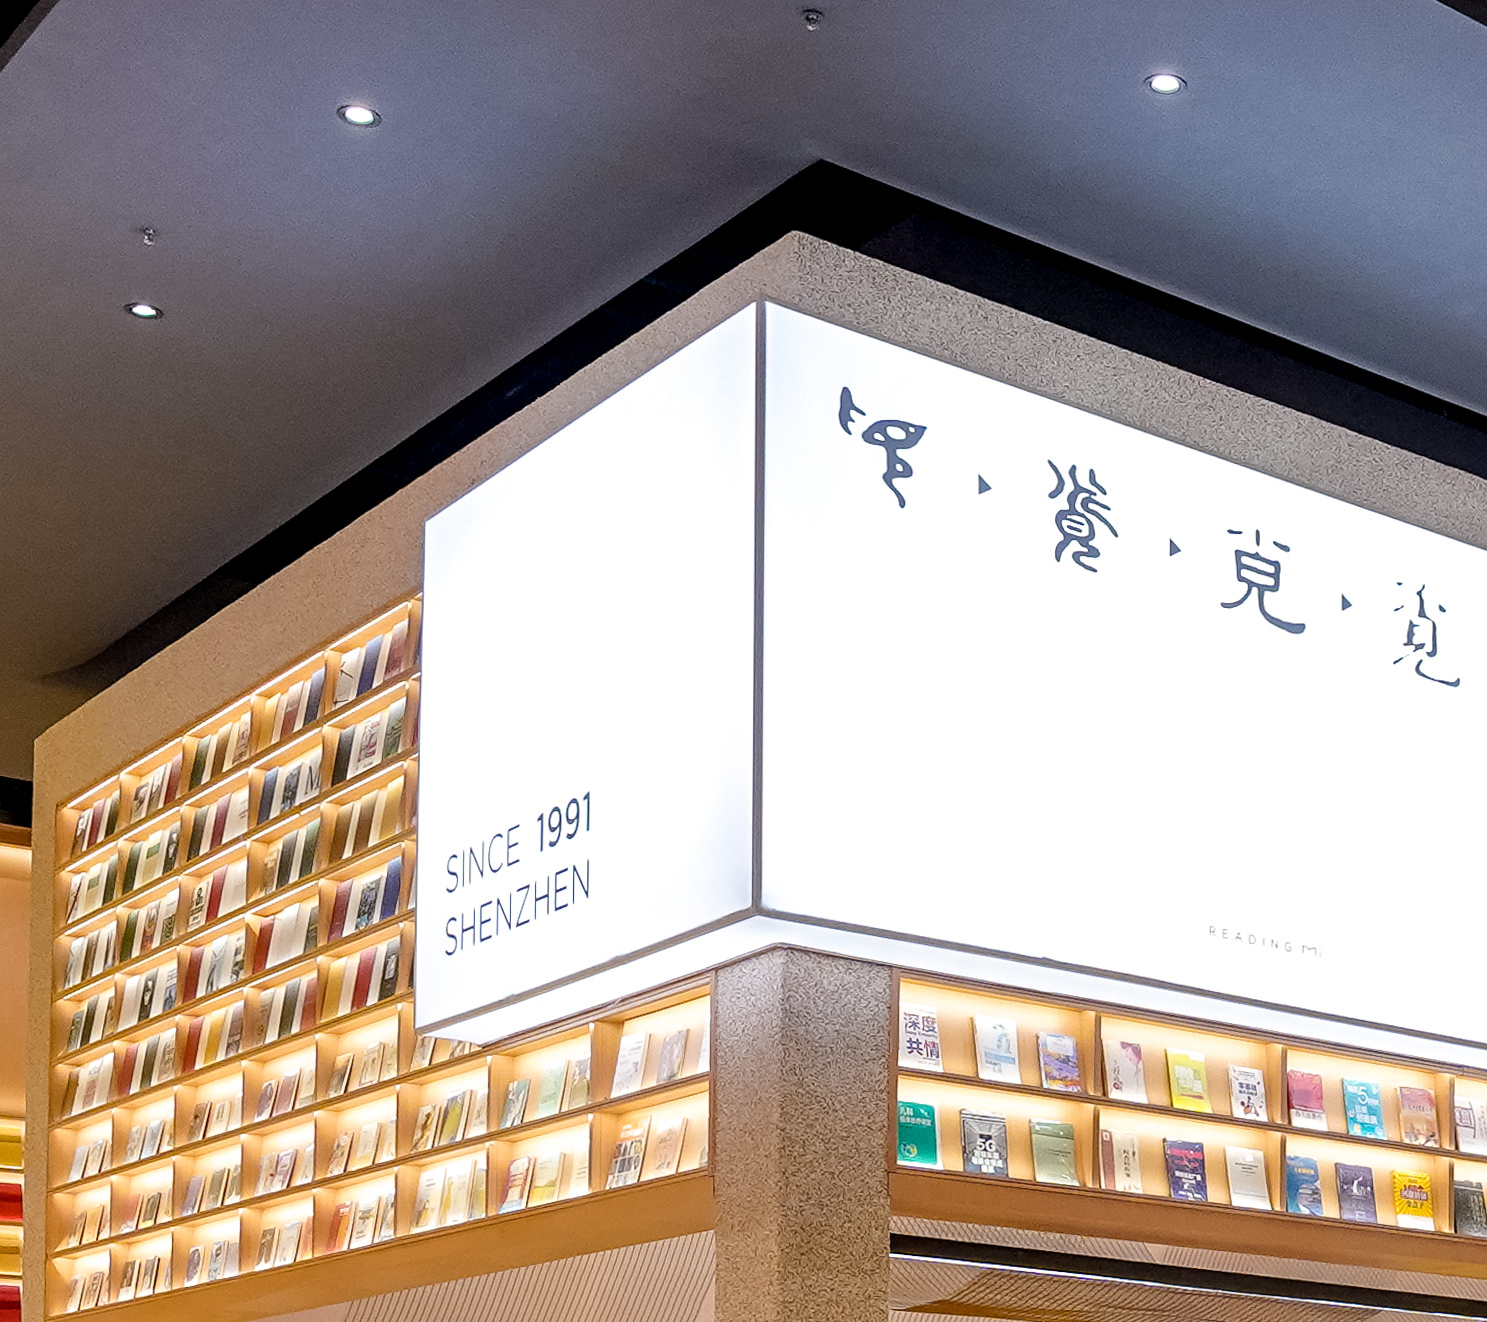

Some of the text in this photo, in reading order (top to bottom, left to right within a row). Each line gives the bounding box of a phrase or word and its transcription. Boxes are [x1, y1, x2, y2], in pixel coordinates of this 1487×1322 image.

[446, 791, 591, 894] SINCE 1991
[445, 859, 590, 956] SHENZHEN
[1209, 926, 1292, 953] READING
